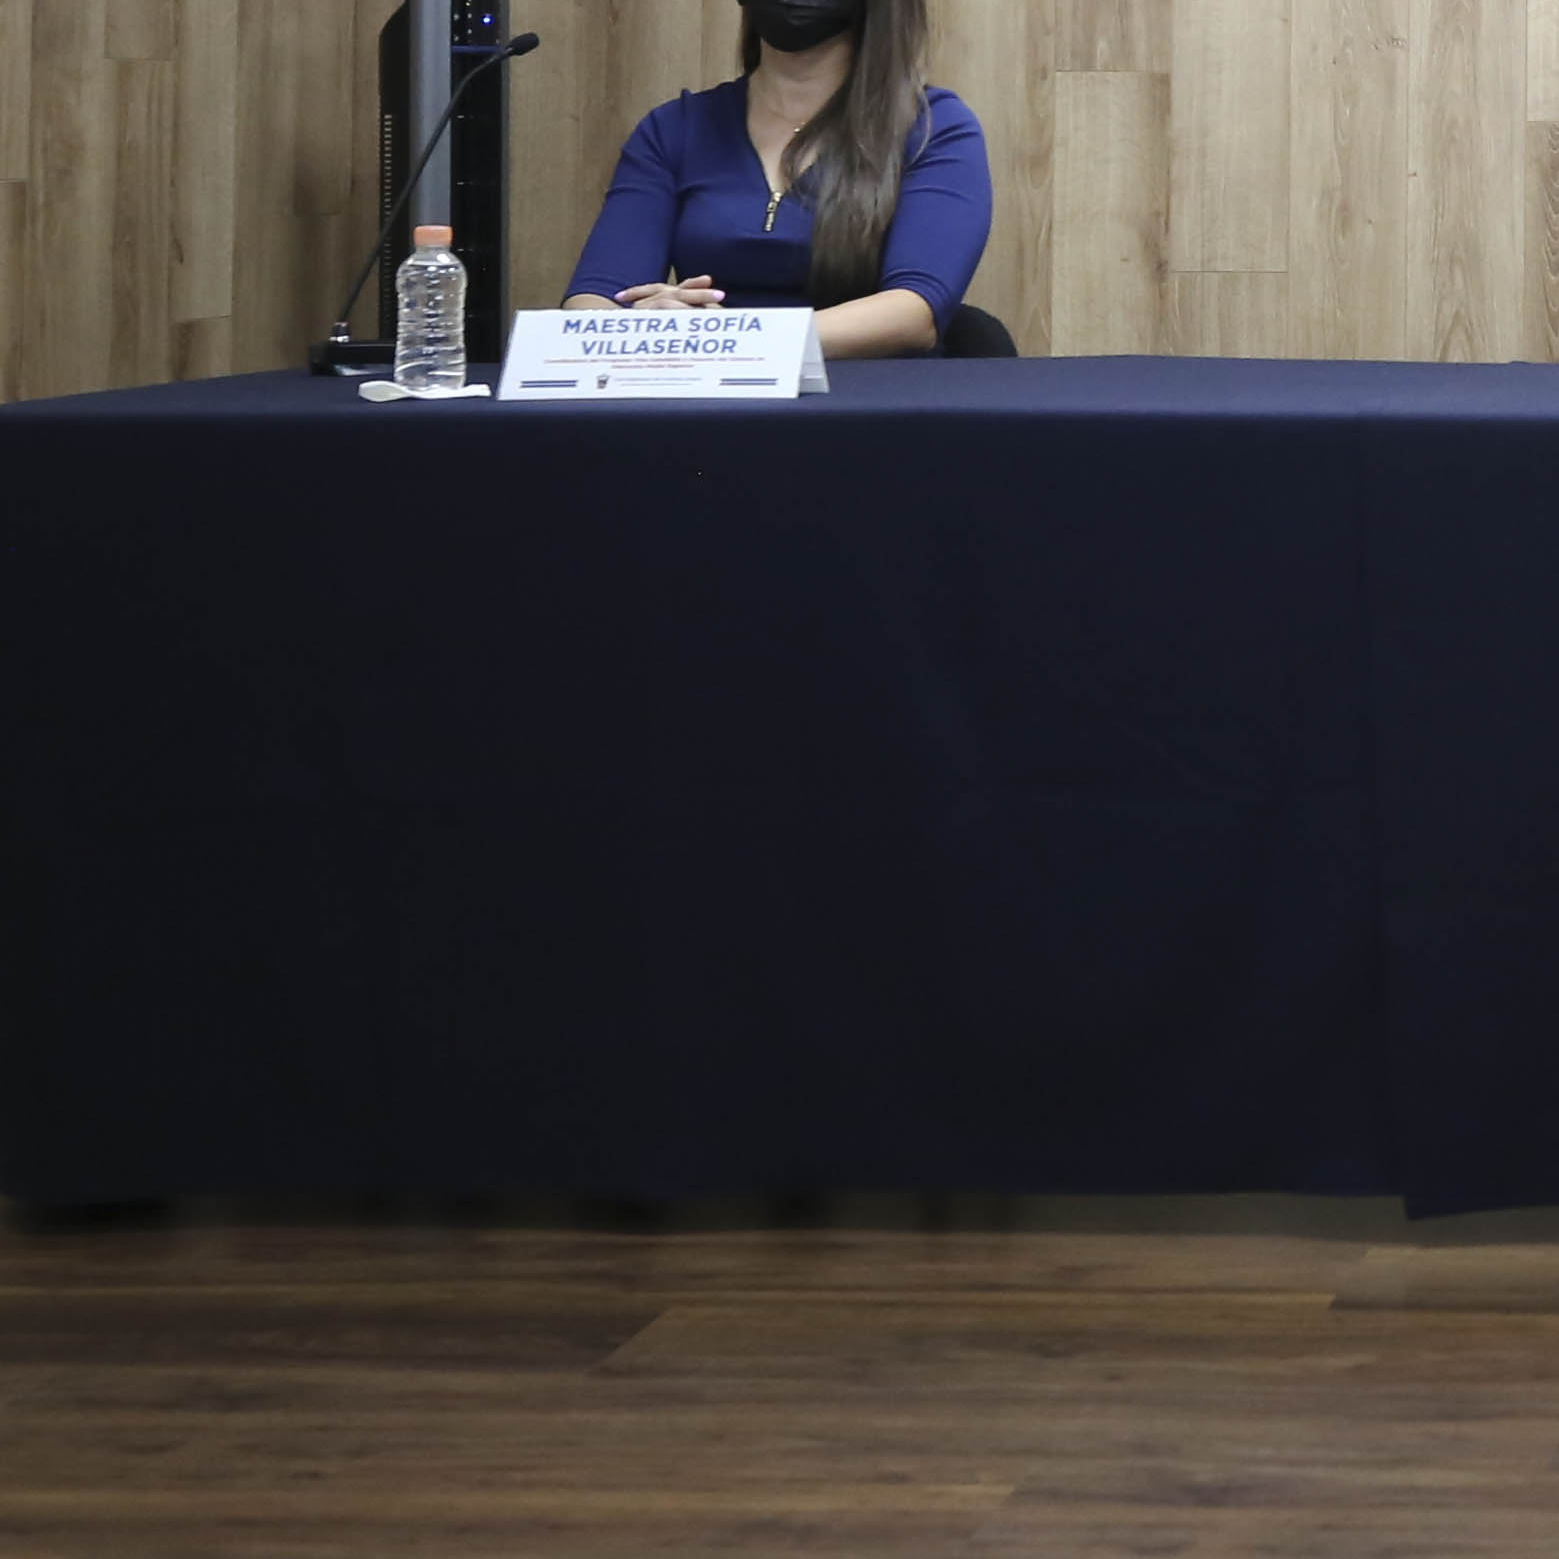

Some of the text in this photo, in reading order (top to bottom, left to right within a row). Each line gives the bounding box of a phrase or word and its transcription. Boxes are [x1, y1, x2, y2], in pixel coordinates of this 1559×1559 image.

[562, 314, 762, 334] MAESTRA SOFÍA
[581, 334, 737, 355] VILLASEÑOR
